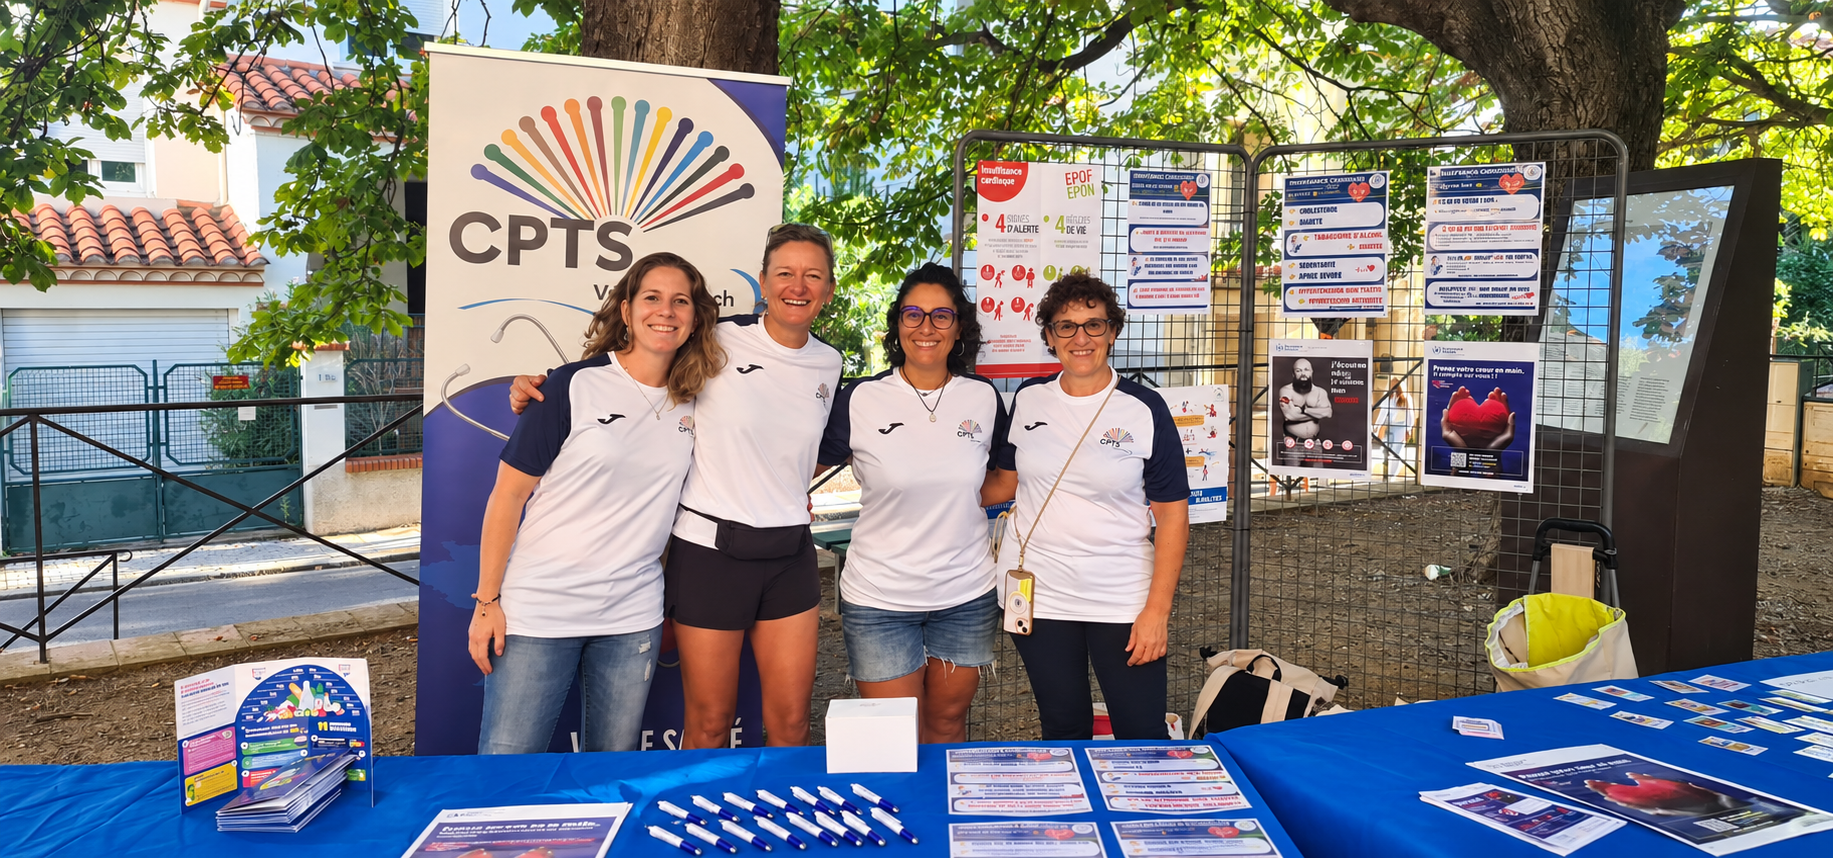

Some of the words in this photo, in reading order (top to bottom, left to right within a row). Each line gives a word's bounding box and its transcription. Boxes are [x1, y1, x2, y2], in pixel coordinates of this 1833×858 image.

[1065, 169, 1093, 186] EPOF
[1067, 184, 1095, 200] EPON
[995, 213, 1006, 233] 4
[1055, 215, 1065, 234] 4
[1066, 226, 1075, 234] DE
[449, 211, 634, 272] CPTS
[1100, 438, 1121, 448] CPTS
